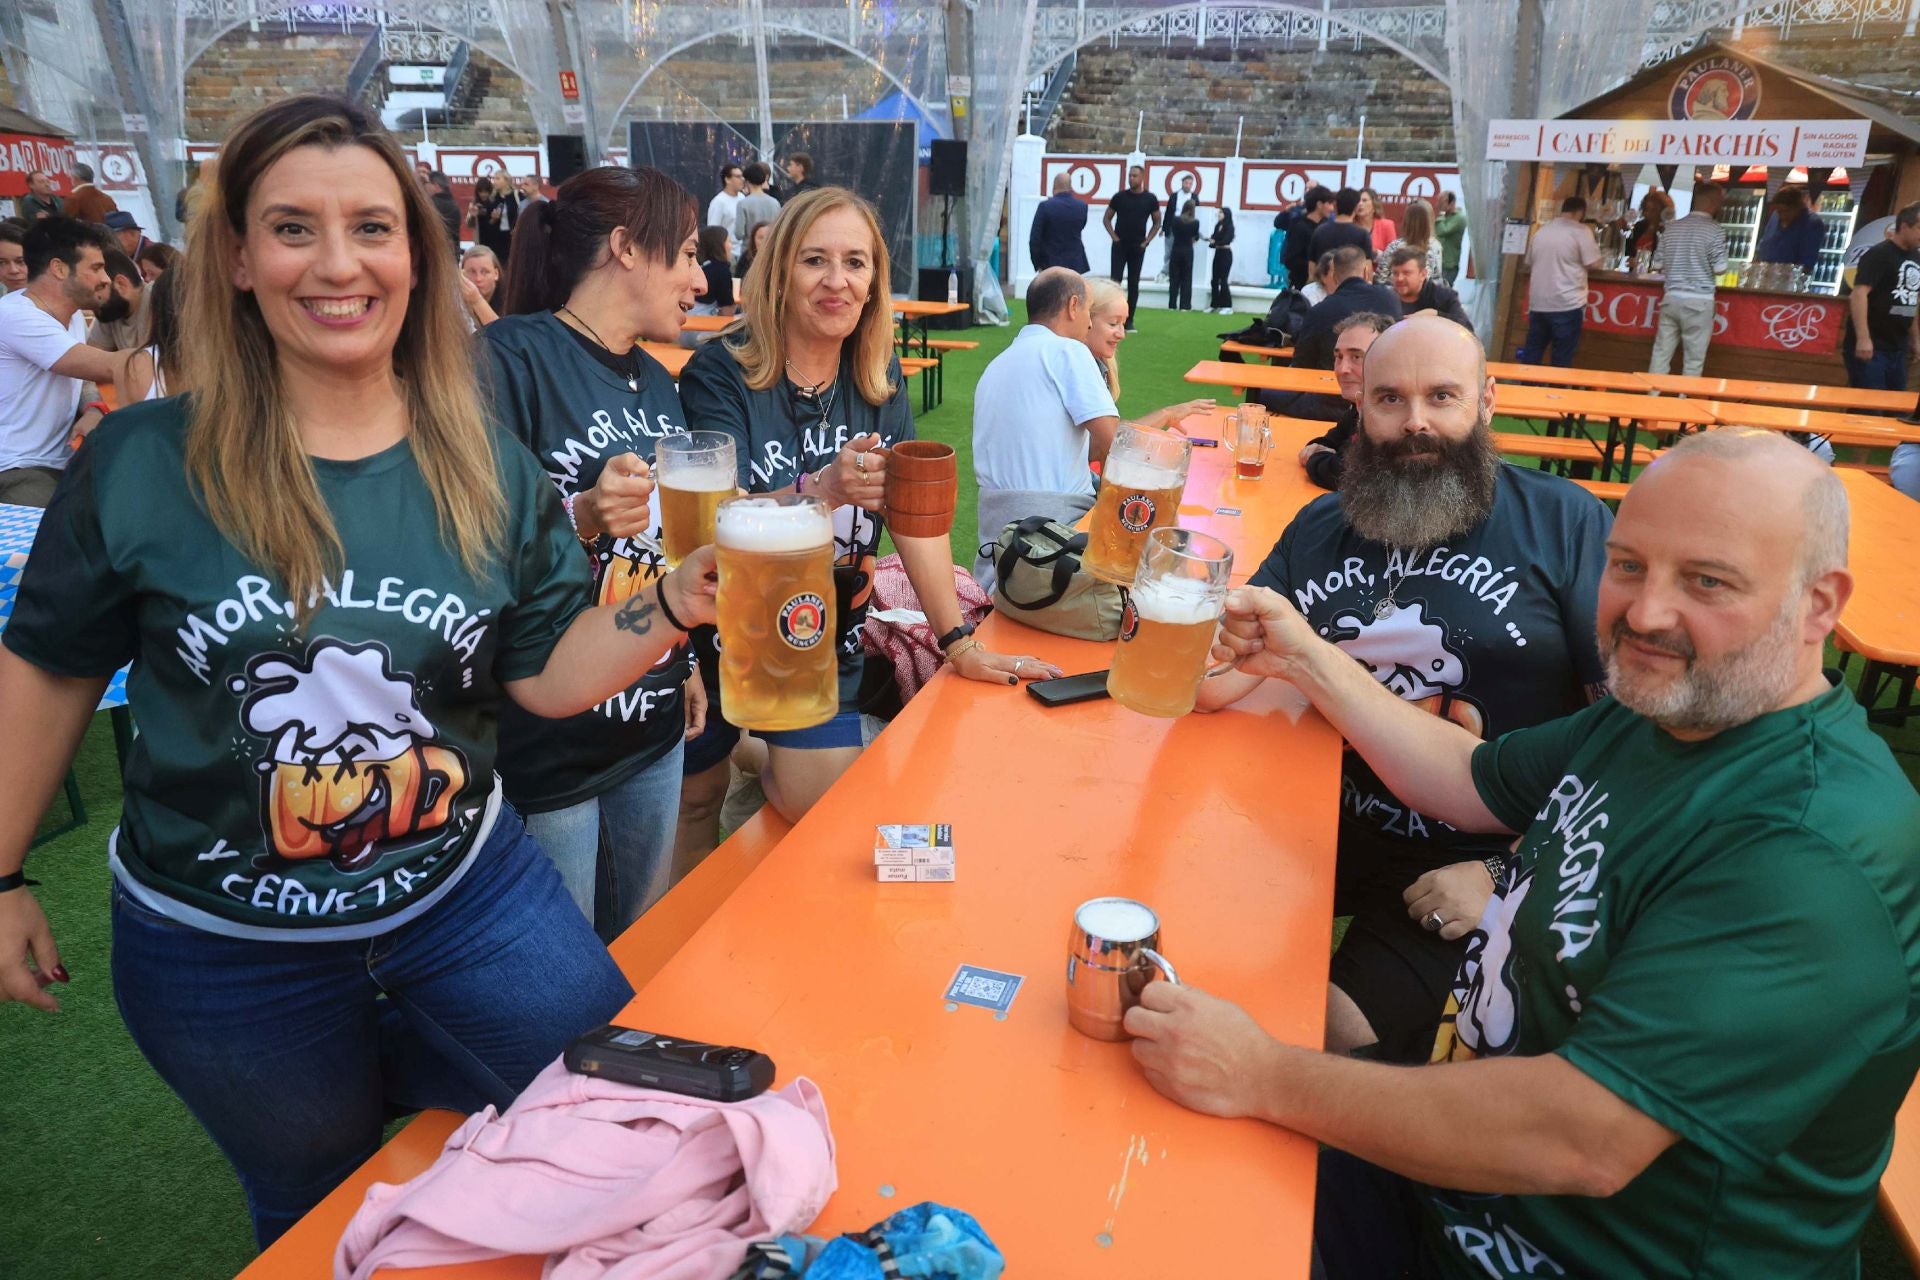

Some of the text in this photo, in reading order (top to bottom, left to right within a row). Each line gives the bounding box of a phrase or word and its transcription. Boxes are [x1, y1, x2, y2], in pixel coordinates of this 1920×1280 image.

[1679, 58, 1755, 90] PAULANER
[1552, 128, 1781, 158] CAFÉ DEL PARCHÍS
[1803, 132, 1859, 141] SIN ALCOHOL
[1806, 150, 1820, 158] SIN
[1295, 557, 1375, 616] MOR,
[782, 595, 824, 618] PAULANER
[197, 838, 240, 861] Y
